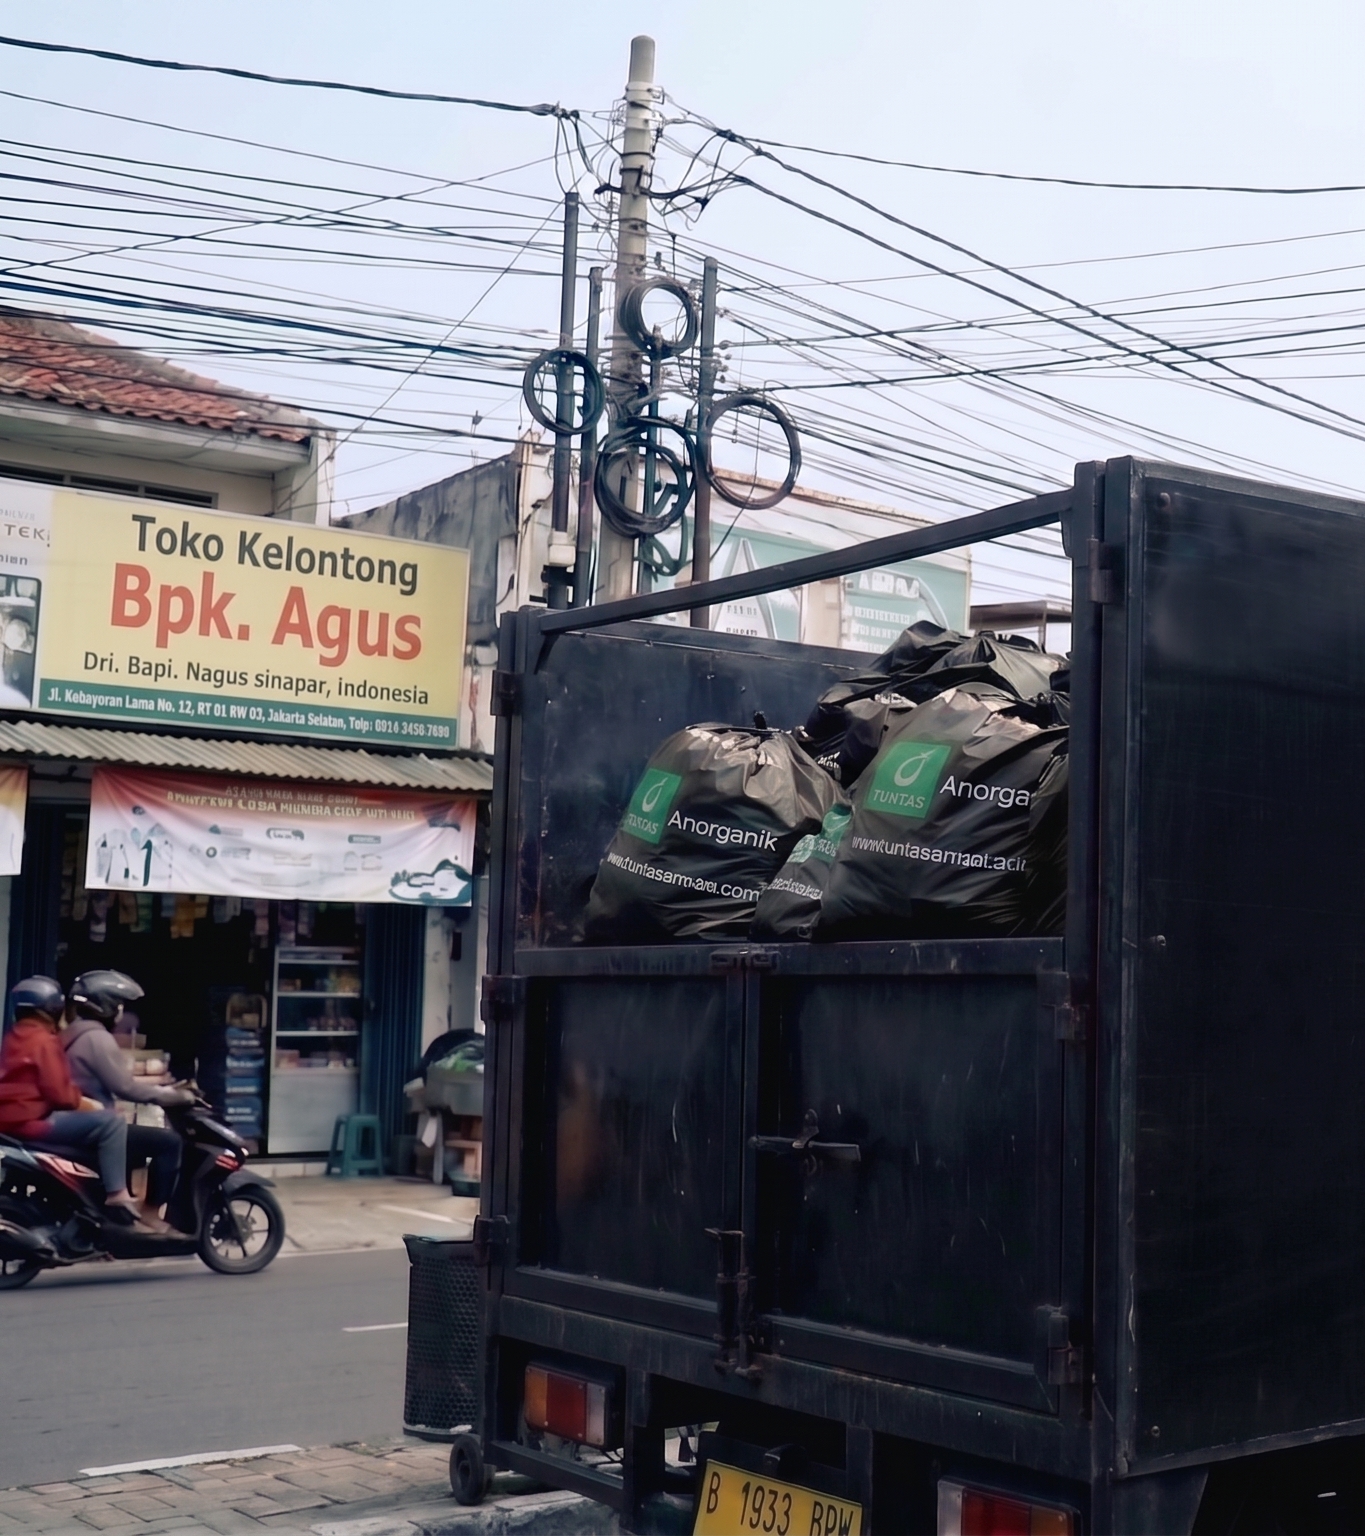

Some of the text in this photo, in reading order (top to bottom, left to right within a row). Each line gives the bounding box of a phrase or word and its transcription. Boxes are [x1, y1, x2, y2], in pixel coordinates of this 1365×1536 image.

[132, 514, 418, 596] Toko Kelontong
[110, 562, 422, 668] Bpk. Agus
[84, 651, 429, 706] Dri. Bapi. Nagus sinapar, indonesia
[65, 688, 123, 709] Kebayoran
[125, 695, 155, 711] Lama
[157, 698, 175, 713] No.
[178, 700, 194, 716] 12,
[198, 702, 212, 715] RT
[214, 703, 227, 718] 01
[230, 705, 247, 719] RW
[249, 706, 265, 723] 03,
[267, 708, 305, 725] Jakarta
[307, 712, 346, 731] Selatan,
[873, 789, 925, 809] TUNTAS
[939, 775, 1031, 808] Anorga
[667, 810, 778, 851] Anorganik
[706, 1471, 721, 1514] B
[740, 1481, 792, 1536] 1933
